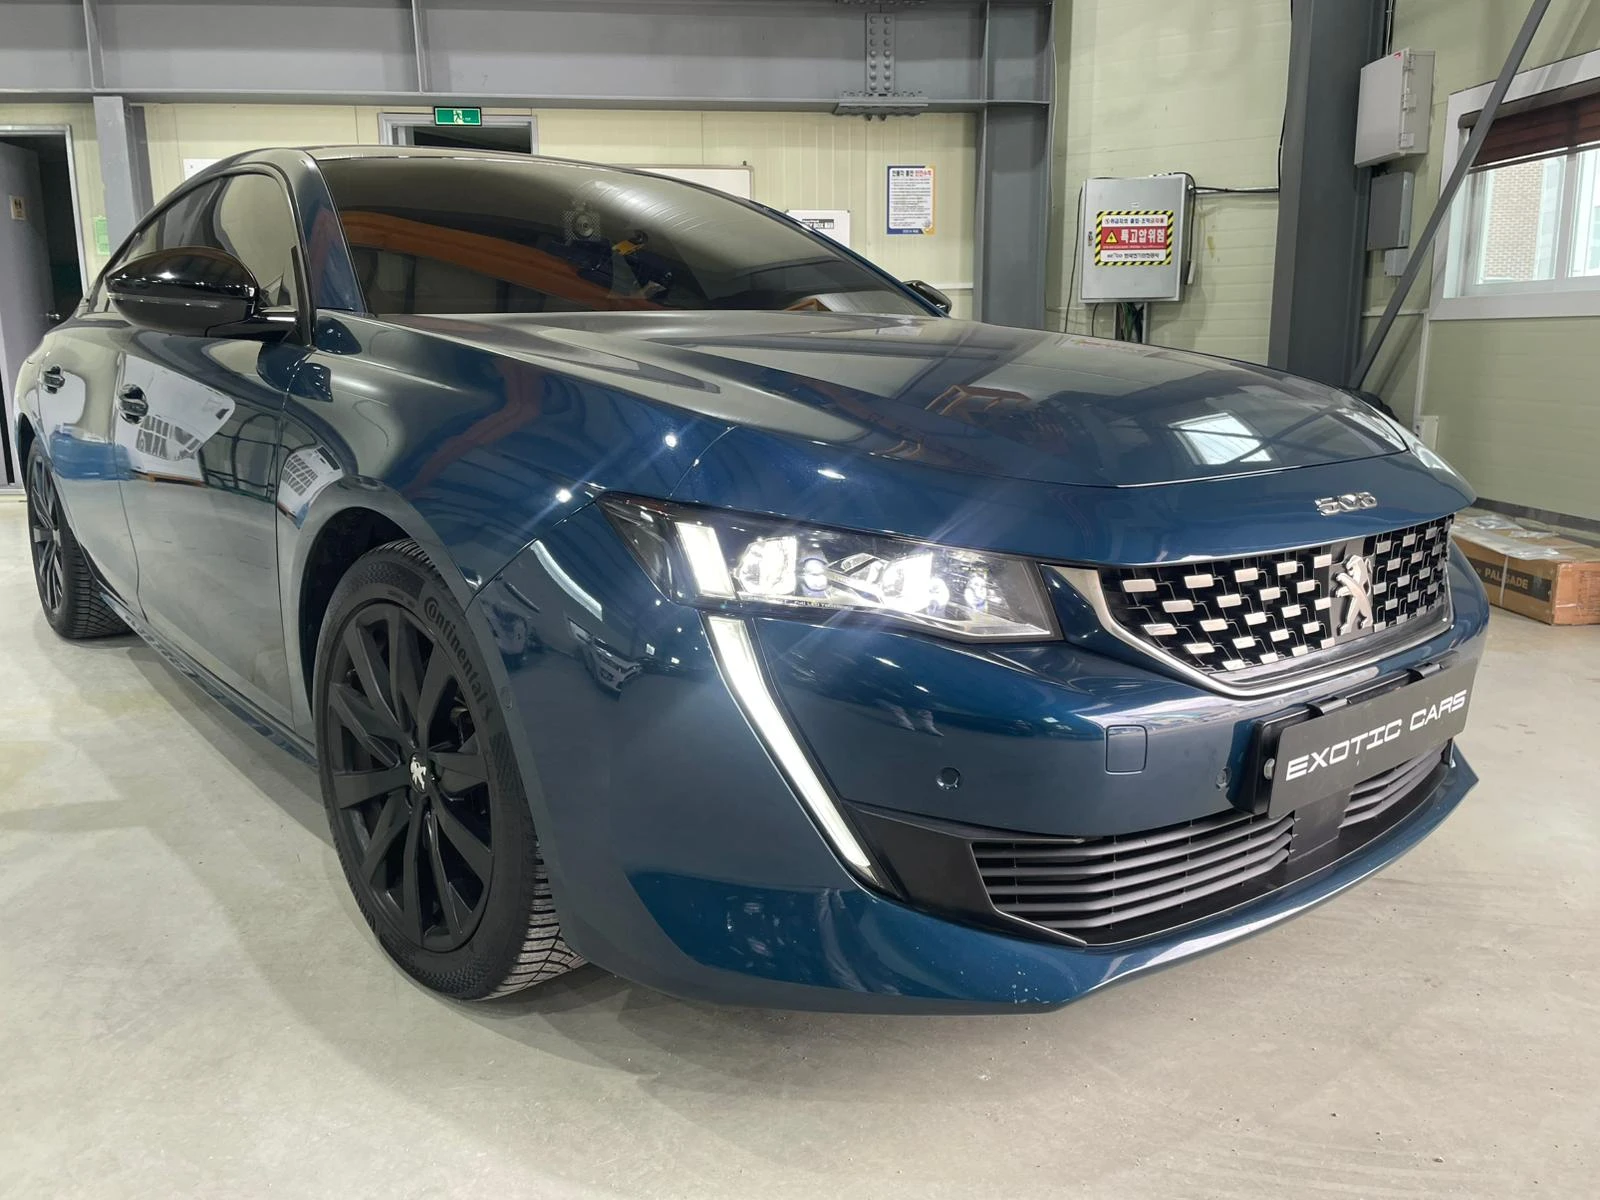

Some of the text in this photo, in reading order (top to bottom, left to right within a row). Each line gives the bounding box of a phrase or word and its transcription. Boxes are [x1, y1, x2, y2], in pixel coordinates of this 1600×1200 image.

[1484, 567, 1529, 590] PALSADE
[424, 597, 488, 703] Continental
[1285, 689, 1467, 781] EXOTIC CARS
